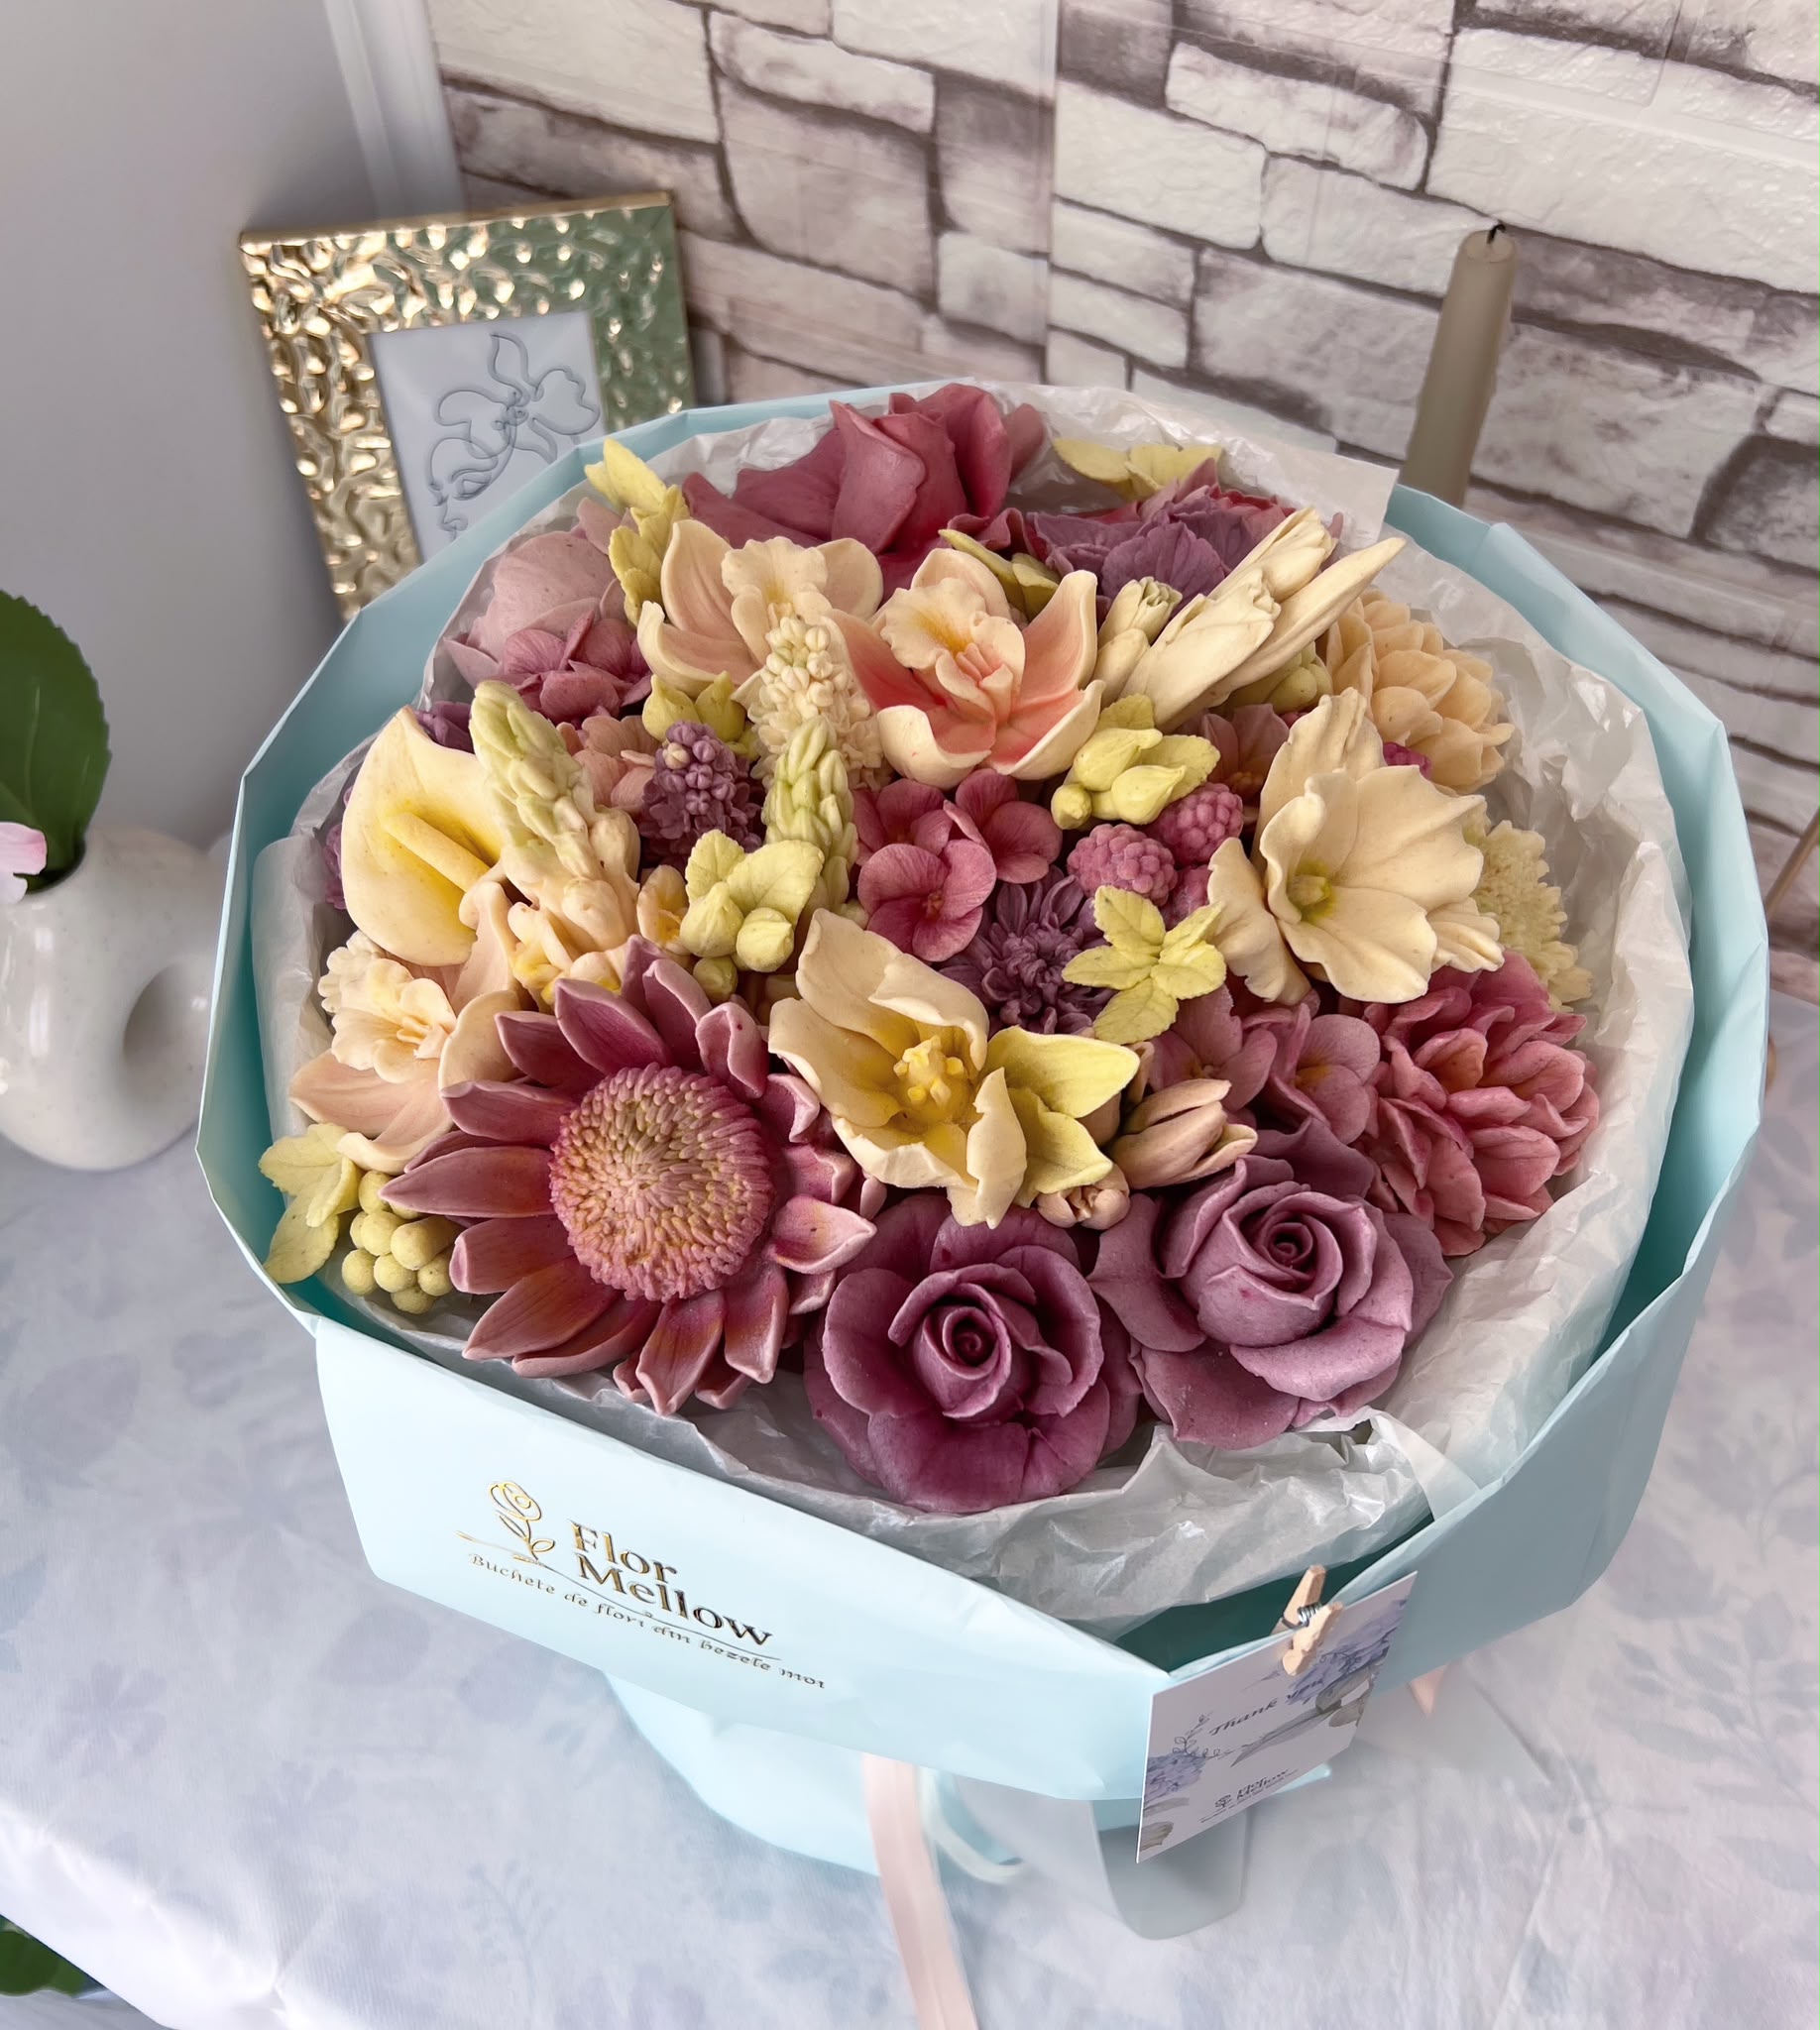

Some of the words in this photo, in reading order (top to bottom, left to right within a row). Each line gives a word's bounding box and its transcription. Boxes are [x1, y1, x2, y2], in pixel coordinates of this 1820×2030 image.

[568, 1520, 678, 1584] Flor
[469, 1553, 555, 1595] Buchete
[564, 1592, 588, 1607] de
[593, 1603, 644, 1629] flori
[699, 1639, 771, 1671] bezele
[778, 1667, 826, 1690] moi
[574, 1551, 773, 1646] Mellow
[1208, 1697, 1278, 1737] Thank
